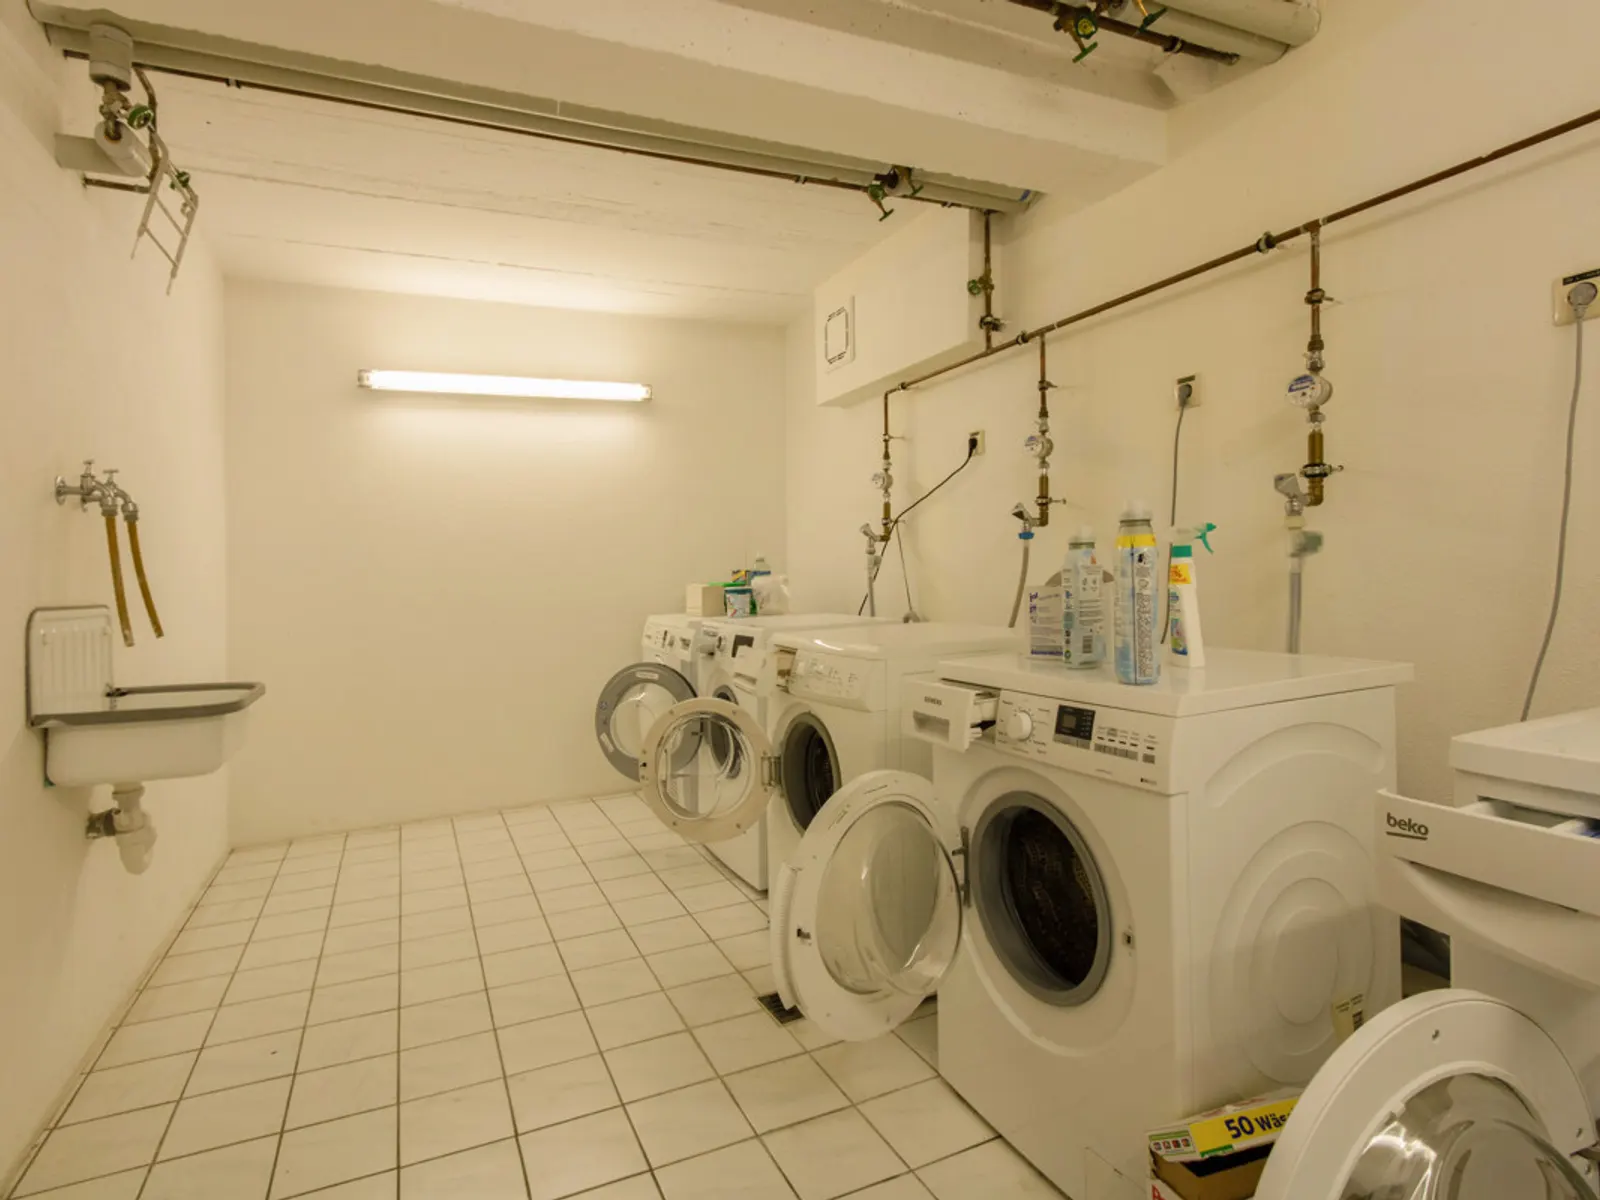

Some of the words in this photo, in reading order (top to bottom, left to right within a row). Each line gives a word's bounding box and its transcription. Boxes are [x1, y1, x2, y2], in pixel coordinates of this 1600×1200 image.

[1386, 812, 1429, 836] beko
[1224, 1115, 1255, 1139] 50
[1254, 1111, 1291, 1132] Wäs
